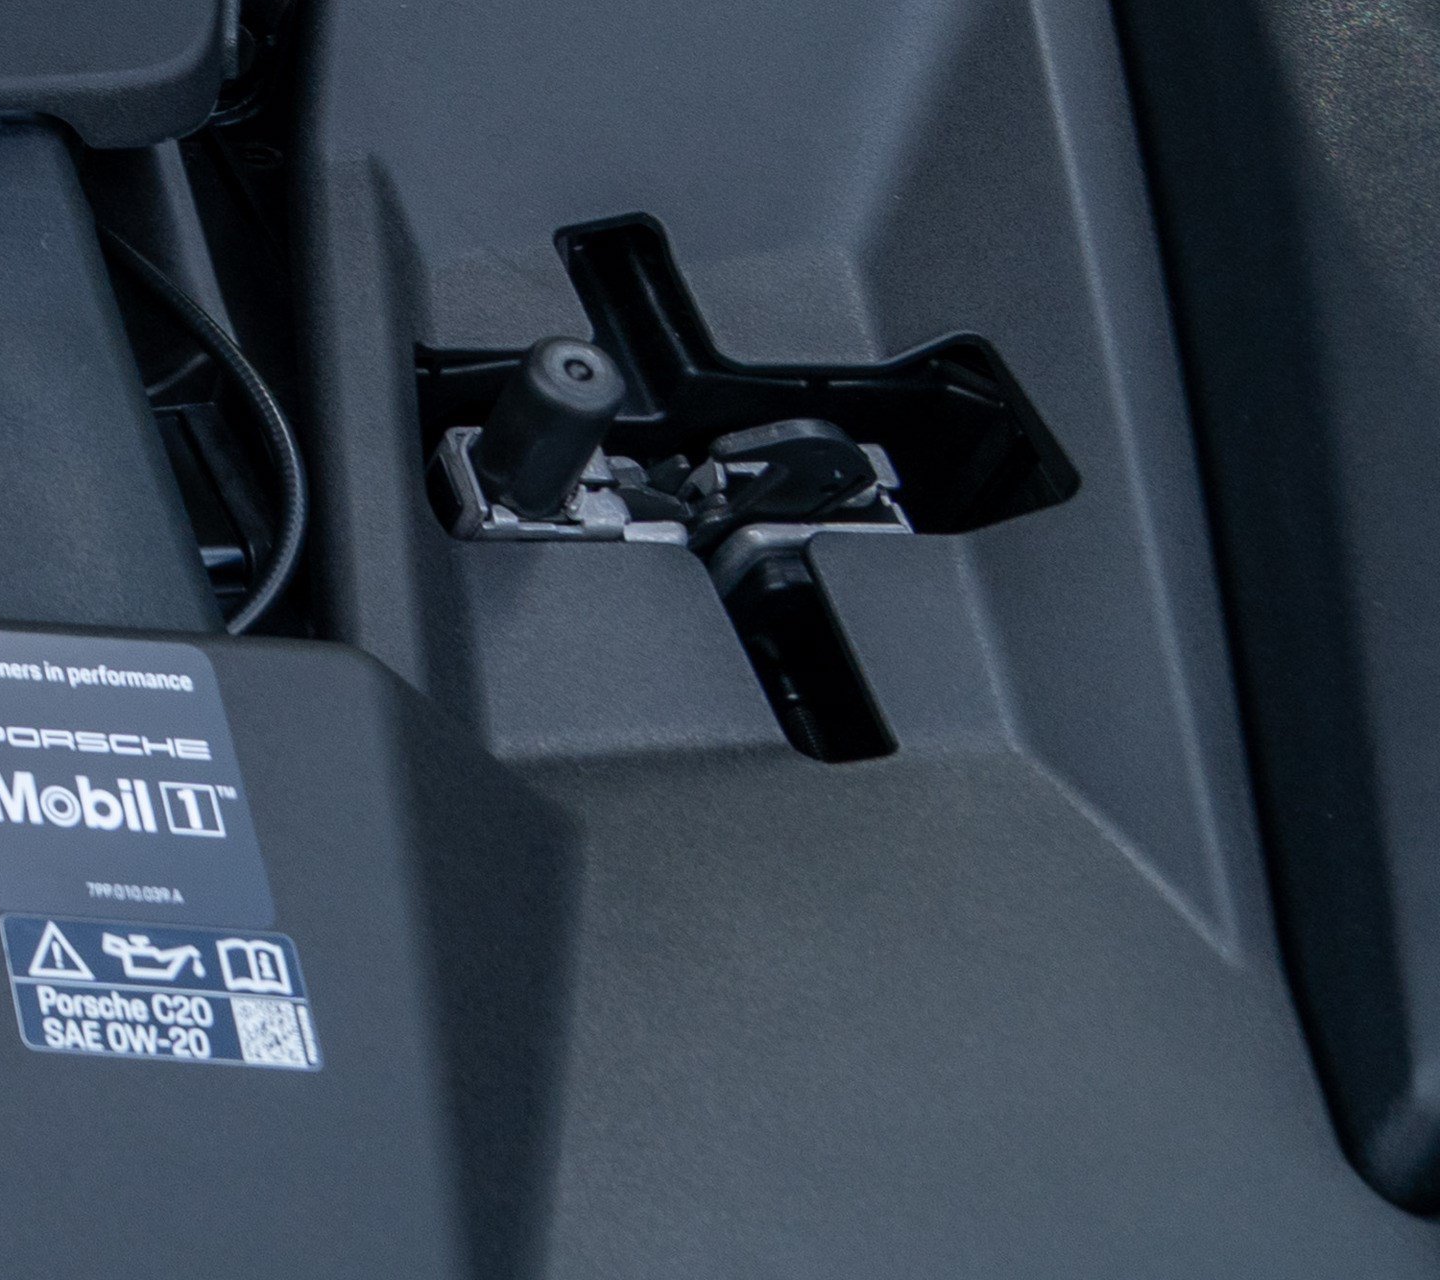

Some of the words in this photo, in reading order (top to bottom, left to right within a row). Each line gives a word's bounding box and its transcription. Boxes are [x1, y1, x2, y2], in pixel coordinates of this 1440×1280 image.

[43, 660, 66, 683] in
[66, 664, 194, 692] performance
[35, 984, 150, 1023] Porsche
[151, 992, 214, 1029] C20
[42, 1016, 106, 1053] SAE
[105, 1020, 212, 1060] 0W-20
